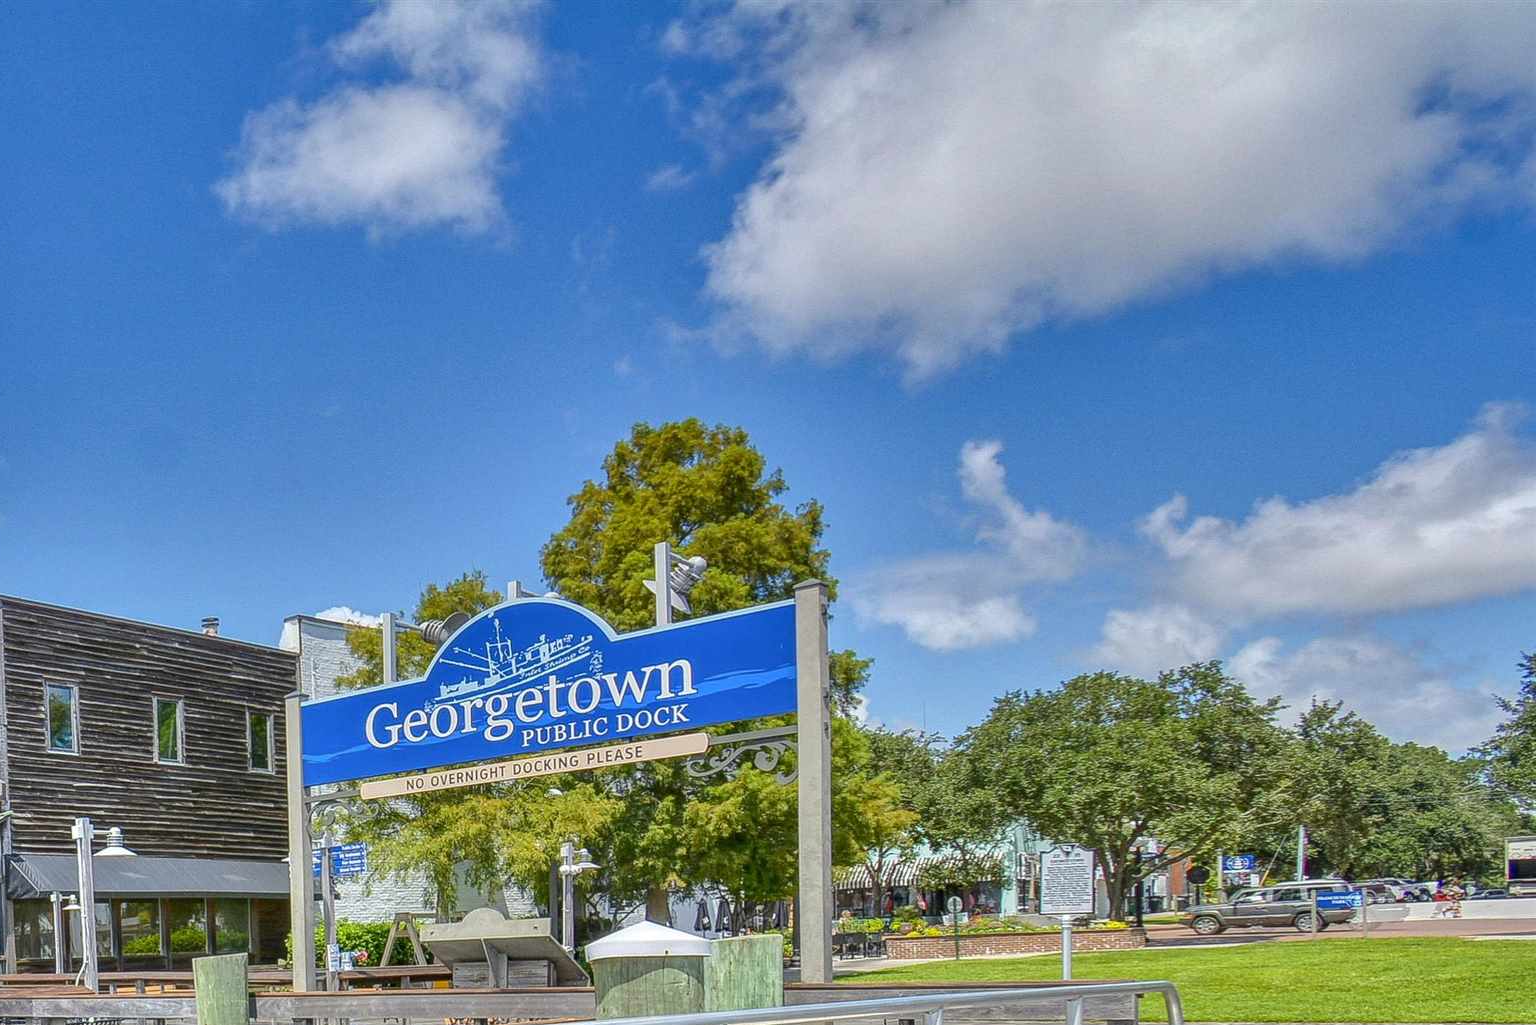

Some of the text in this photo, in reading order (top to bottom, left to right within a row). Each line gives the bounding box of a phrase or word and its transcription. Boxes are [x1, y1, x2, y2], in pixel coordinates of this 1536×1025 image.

[365, 657, 698, 742] Georgetown
[521, 703, 690, 748] PUBLIC DOCK
[406, 745, 643, 790] NO OVERNIGHT DOCKING PLEASE
